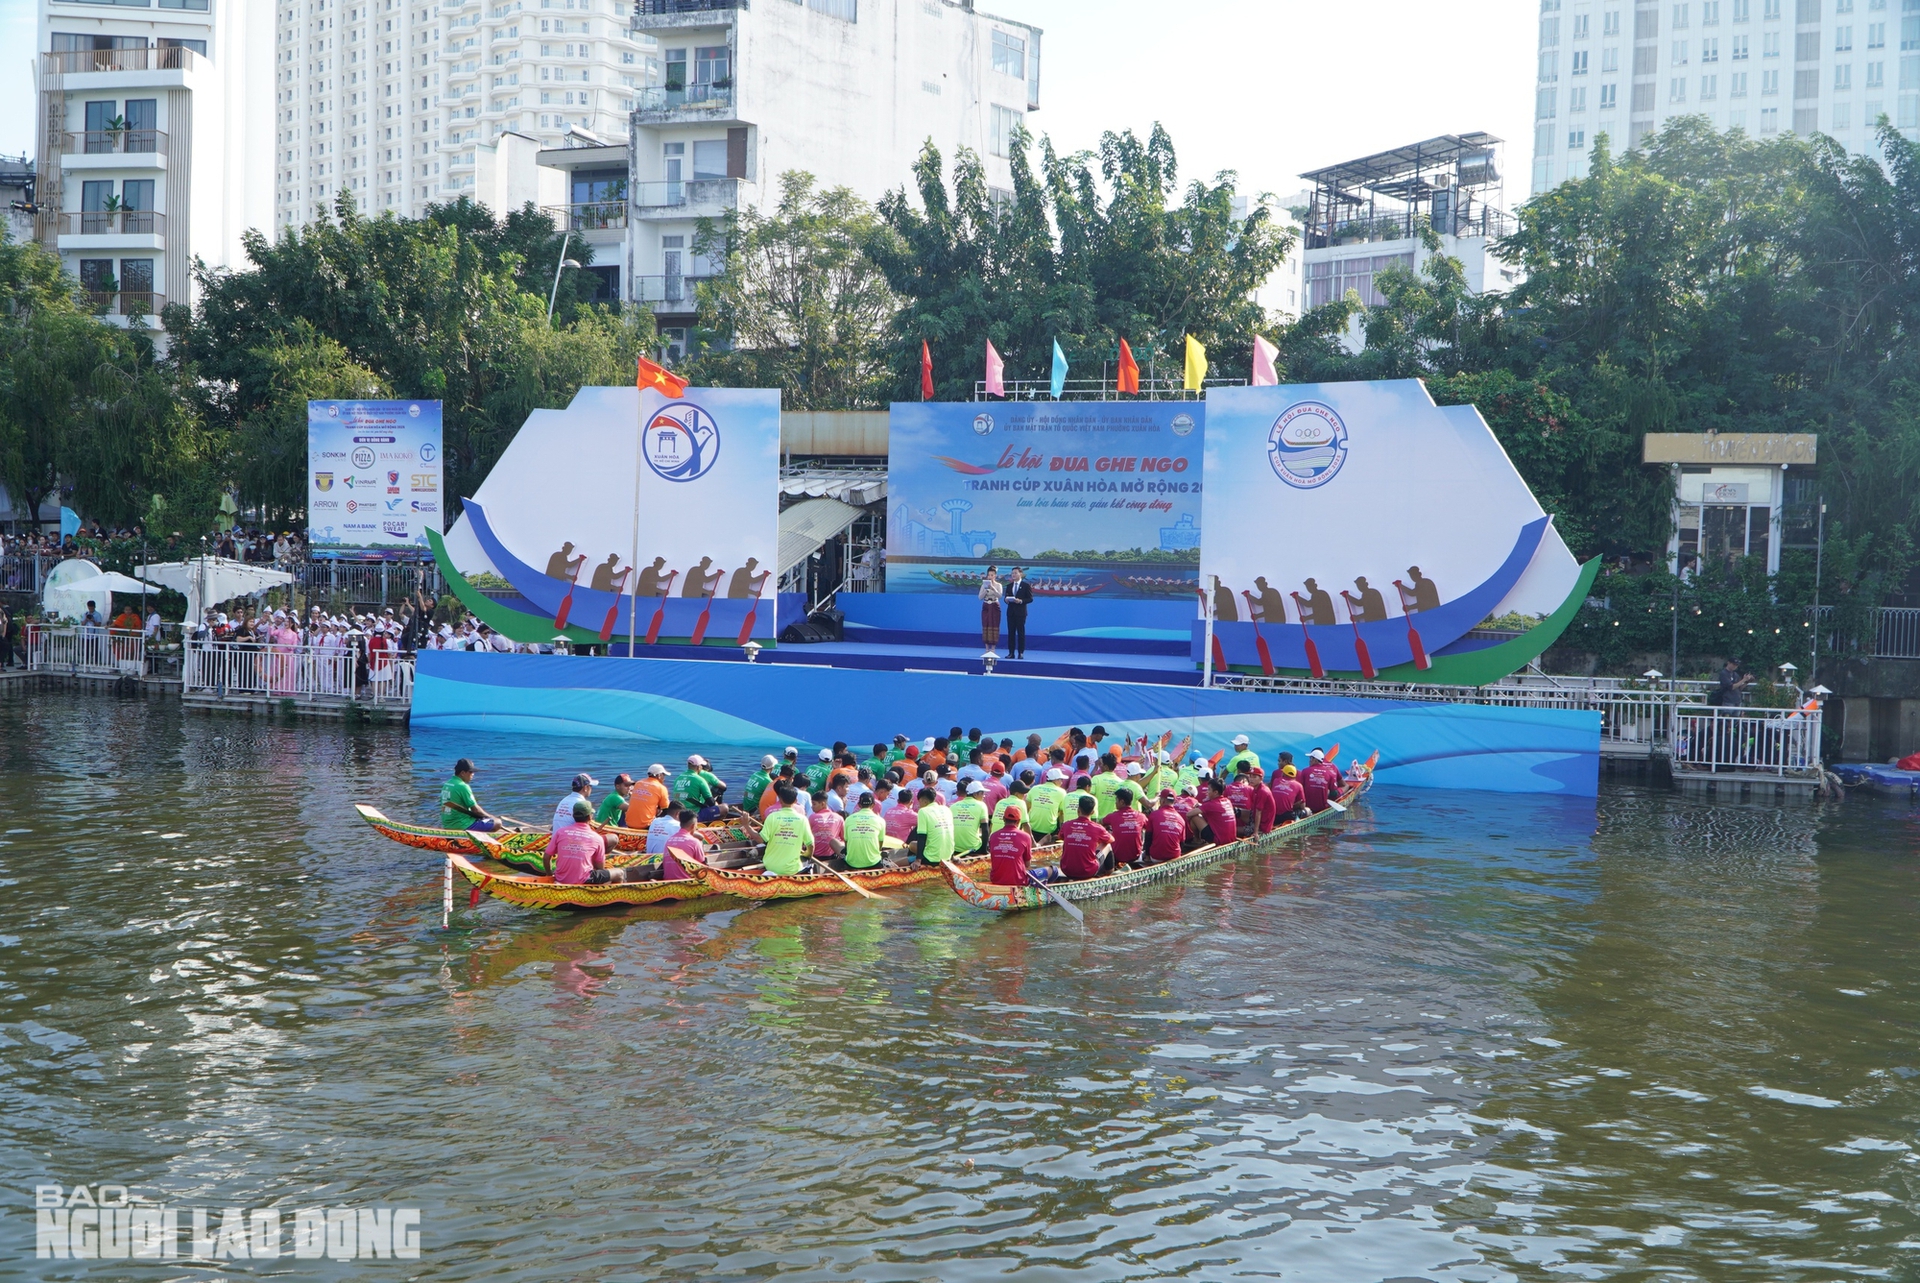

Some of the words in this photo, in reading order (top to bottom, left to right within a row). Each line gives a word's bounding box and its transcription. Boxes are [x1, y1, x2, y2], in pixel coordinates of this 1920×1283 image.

[1040, 415, 1049, 424] HỘI
[1051, 414, 1066, 424] ĐỒNG
[1068, 415, 1083, 424] NHÂN
[1111, 416, 1121, 424] BAN
[1123, 415, 1139, 424] NHÂN
[1276, 423, 1283, 434] LỄ
[1283, 412, 1295, 424] HỘI
[1315, 408, 1329, 417] GHE
[1329, 417, 1340, 432] NGO
[1038, 424, 1052, 433] TRẬN
[1062, 423, 1077, 432] QUỐC
[1080, 424, 1091, 433] VIỆT
[1132, 424, 1147, 432] XUÂN
[1148, 424, 1160, 432] HÒA
[355, 453, 371, 462] PIZZA
[1049, 456, 1089, 472] ĐUA
[1095, 456, 1137, 472] GHE
[1140, 457, 1189, 473] NGO
[1281, 468, 1293, 480] XUÂN
[411, 474, 437, 487] STC
[963, 479, 1010, 491] TRANH
[1013, 477, 1041, 491] CÚP
[1043, 478, 1084, 492] XUÂN
[1086, 478, 1118, 492] HÒA
[1121, 478, 1145, 493] MỞ
[1147, 479, 1189, 496] RỘNG
